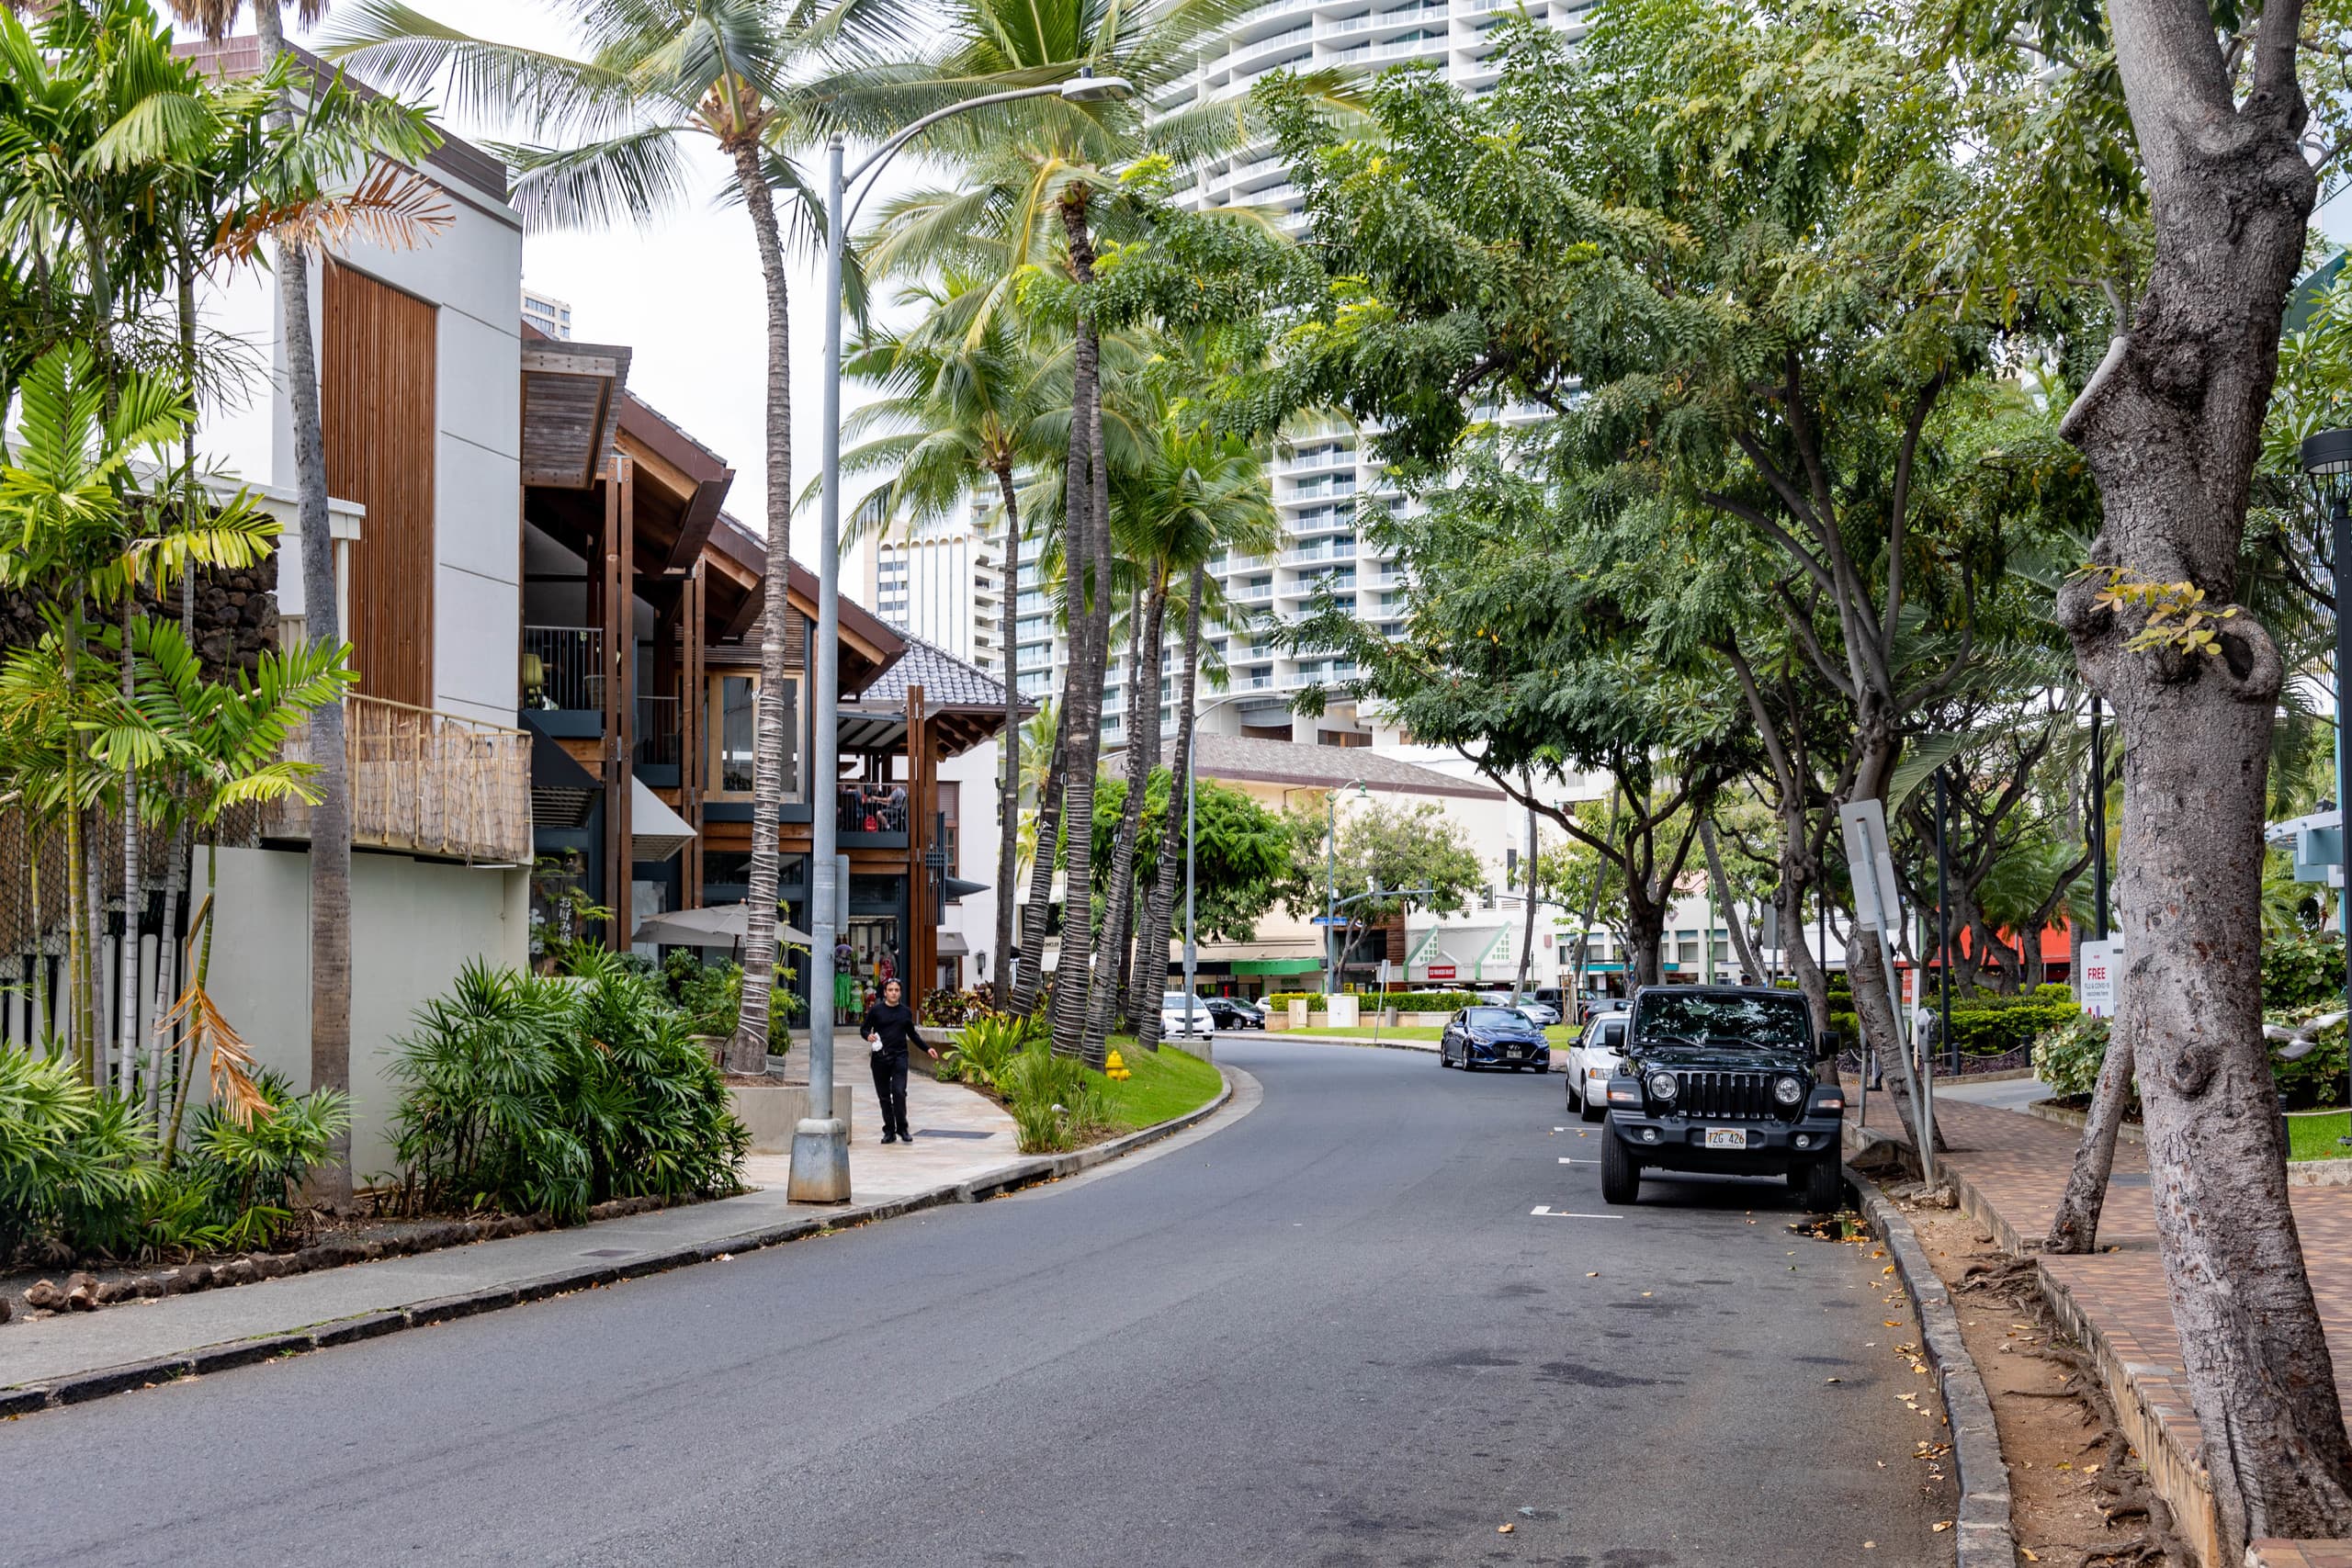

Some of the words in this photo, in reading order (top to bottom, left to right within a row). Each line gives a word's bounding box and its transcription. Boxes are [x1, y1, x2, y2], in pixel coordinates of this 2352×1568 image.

[2087, 967, 2106, 980] FREE
[1708, 1132, 1724, 1144] TZG
[1728, 1133, 1745, 1145] 426
